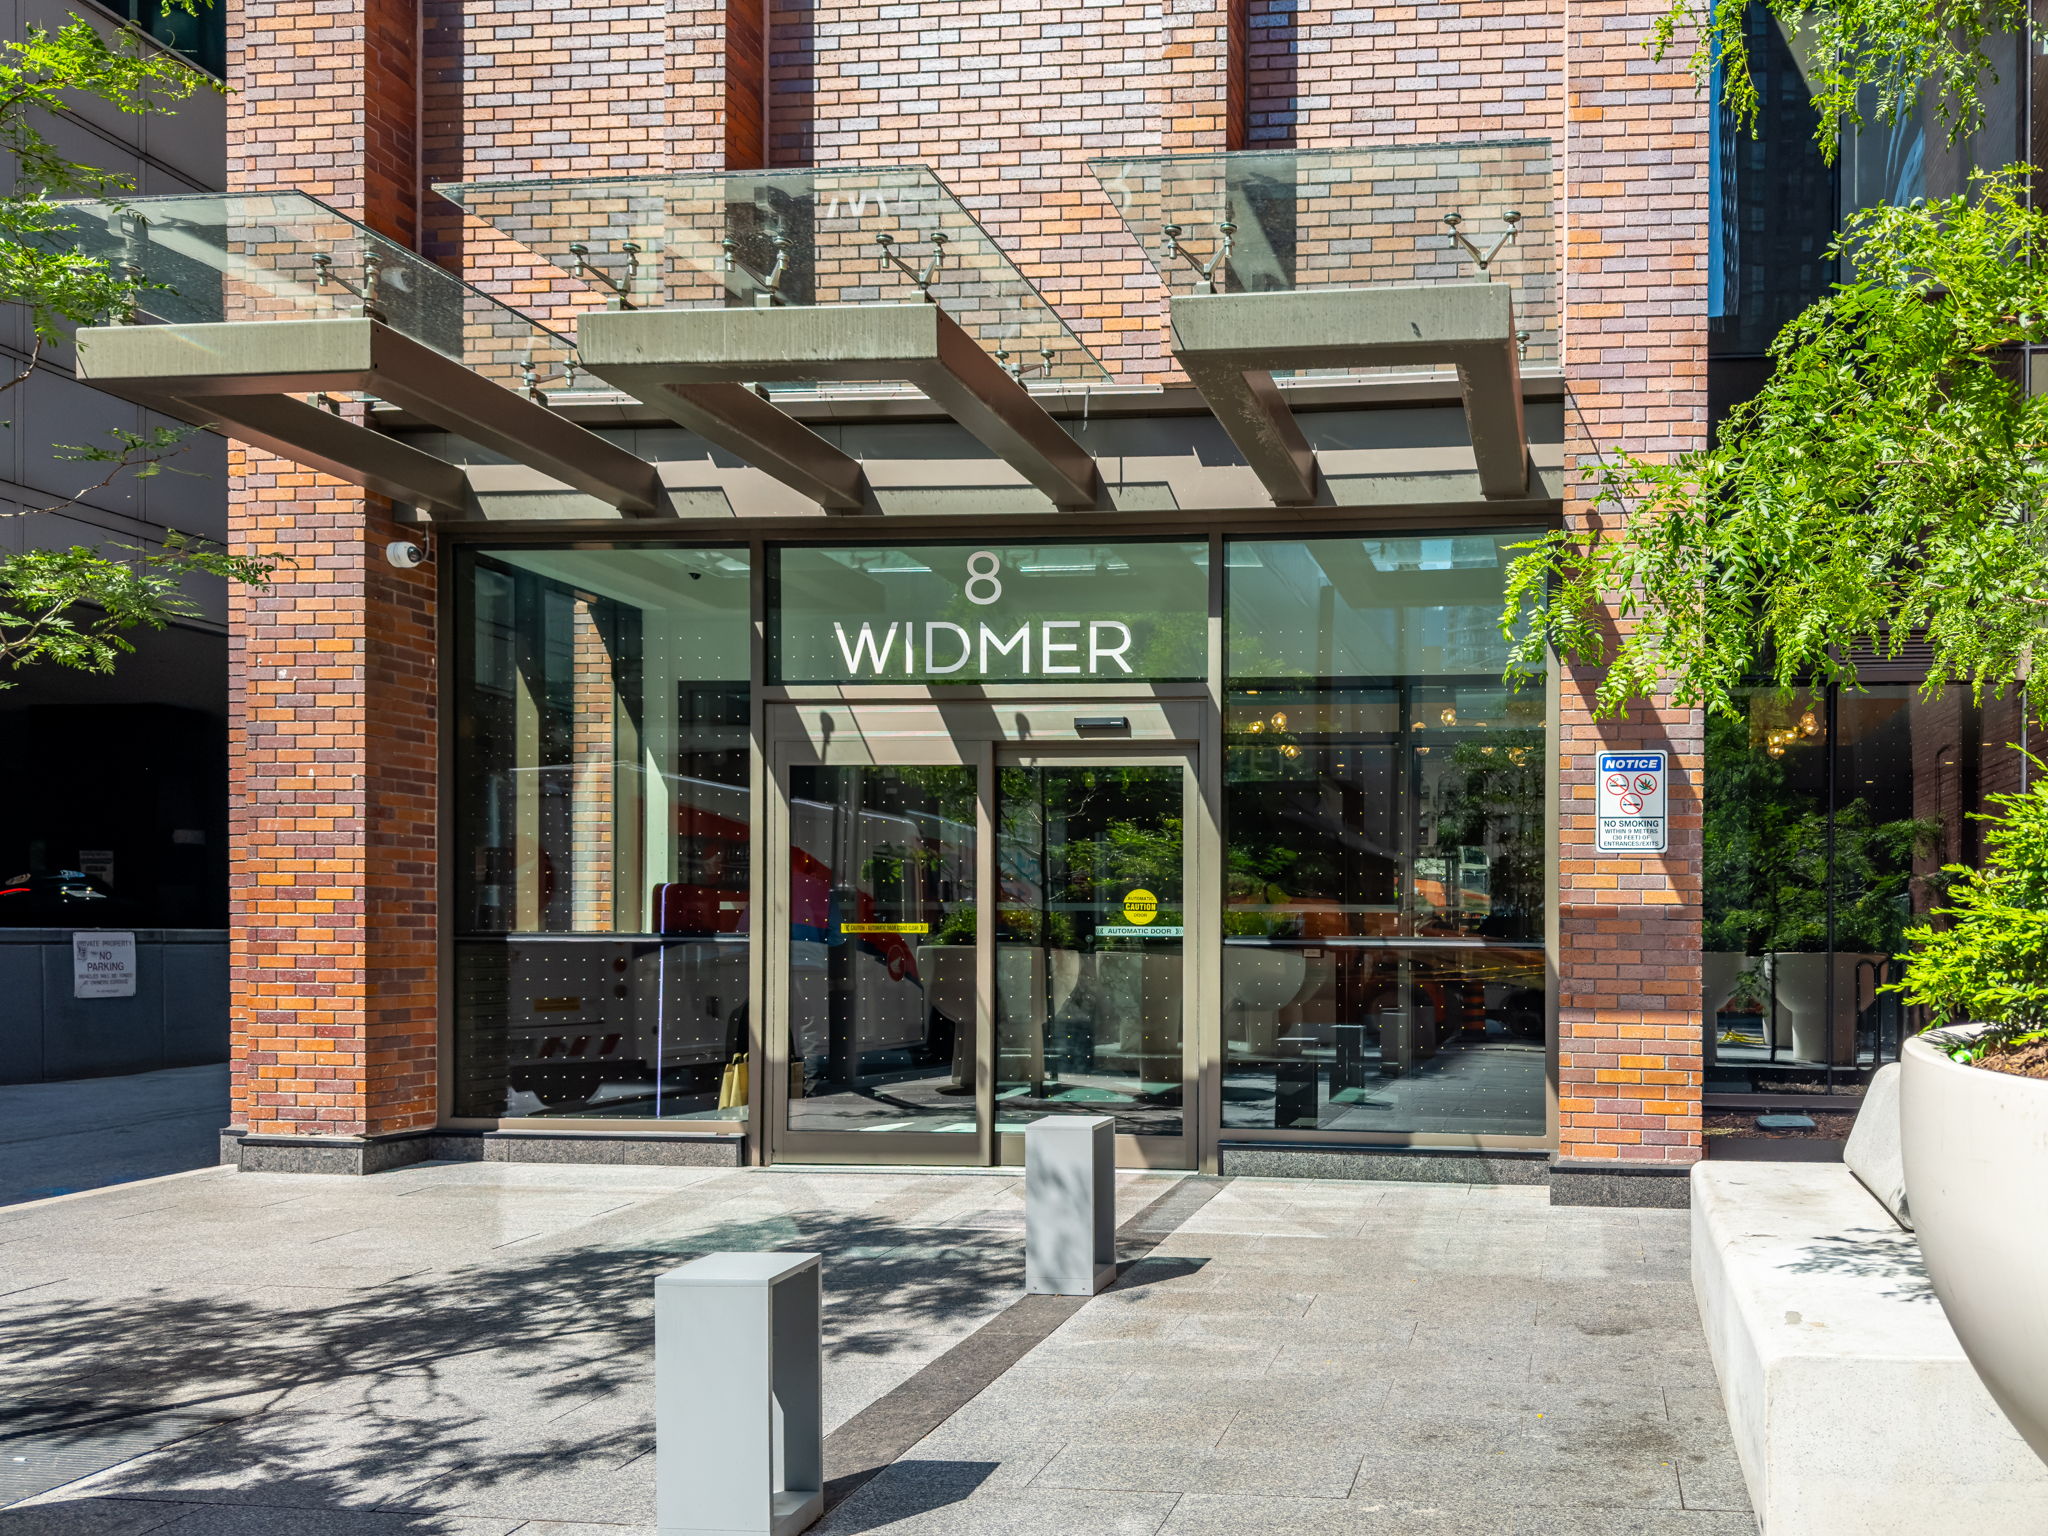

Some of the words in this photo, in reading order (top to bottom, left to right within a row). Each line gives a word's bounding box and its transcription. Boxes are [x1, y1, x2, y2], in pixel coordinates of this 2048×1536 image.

[964, 550, 1003, 605] 8
[833, 619, 1133, 675] WIDMER
[1605, 759, 1658, 769] NOTICE
[1603, 820, 1617, 828] NO
[1618, 820, 1659, 828] SMOKING
[1125, 903, 1156, 911] CAUTION
[99, 951, 112, 961] NO
[87, 961, 125, 972] PARKING
